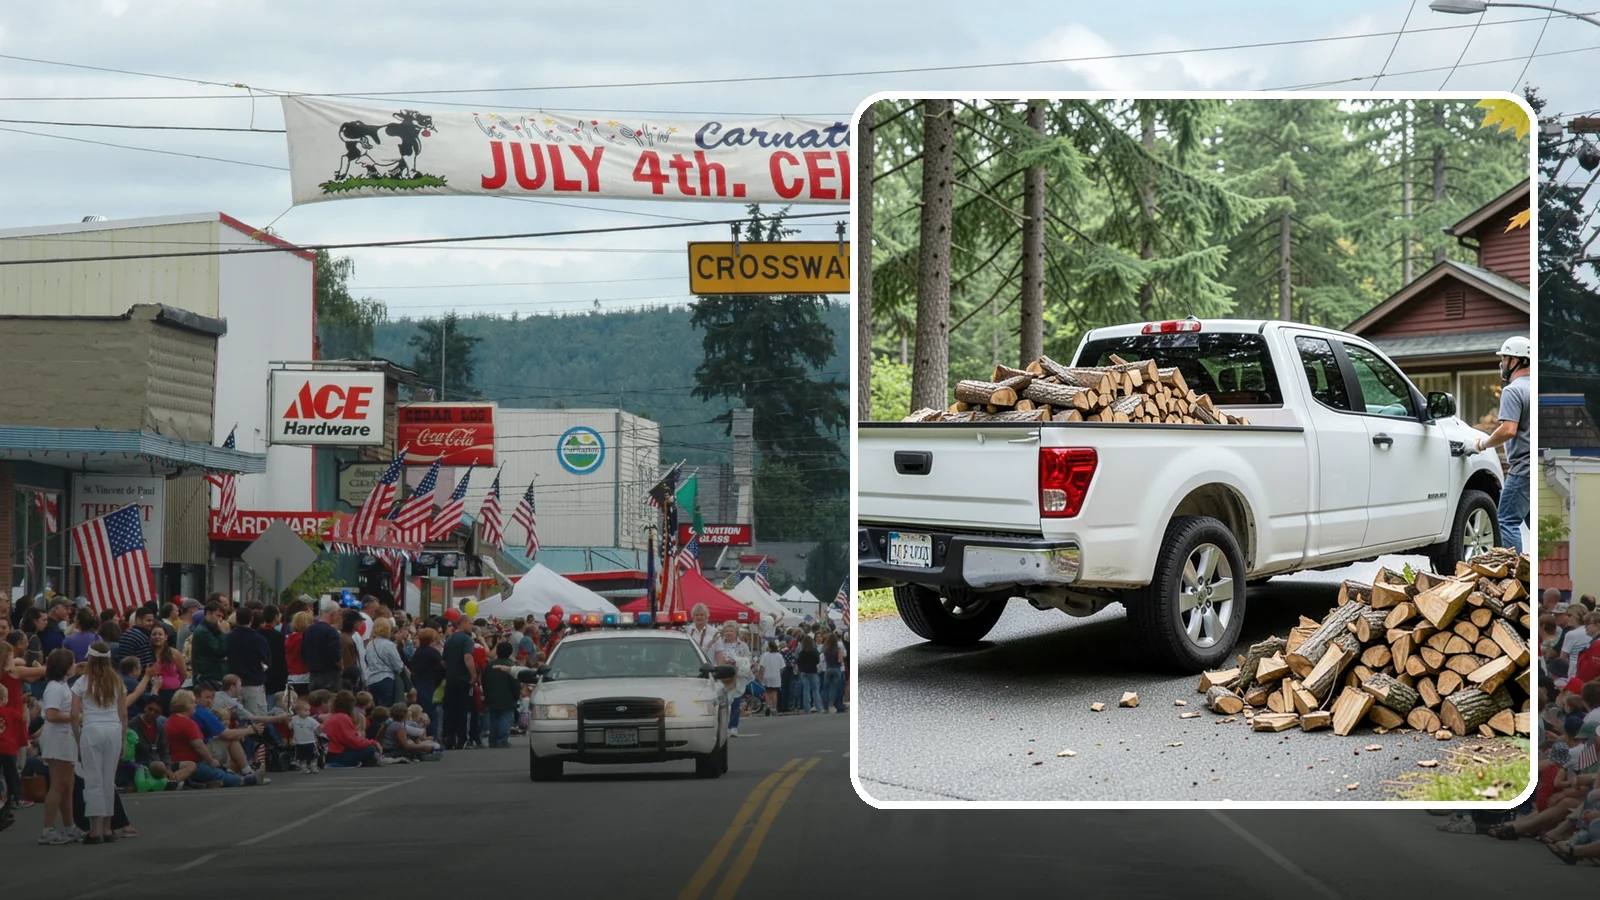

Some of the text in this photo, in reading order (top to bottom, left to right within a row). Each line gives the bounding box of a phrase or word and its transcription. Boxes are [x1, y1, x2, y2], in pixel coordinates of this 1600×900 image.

[481, 141, 605, 193] JULY
[632, 150, 746, 198] 4th.
[697, 254, 850, 280] CROSSWA
[283, 380, 373, 420] ACE
[406, 409, 485, 422] CEDAR LOG
[284, 421, 370, 436] Hardware
[416, 428, 476, 447] Coca-Cola
[353, 467, 385, 480] Simpl
[83, 485, 154, 495] St. Vincent de Paul
[81, 503, 154, 522] THT
[699, 535, 730, 543] GLASS
